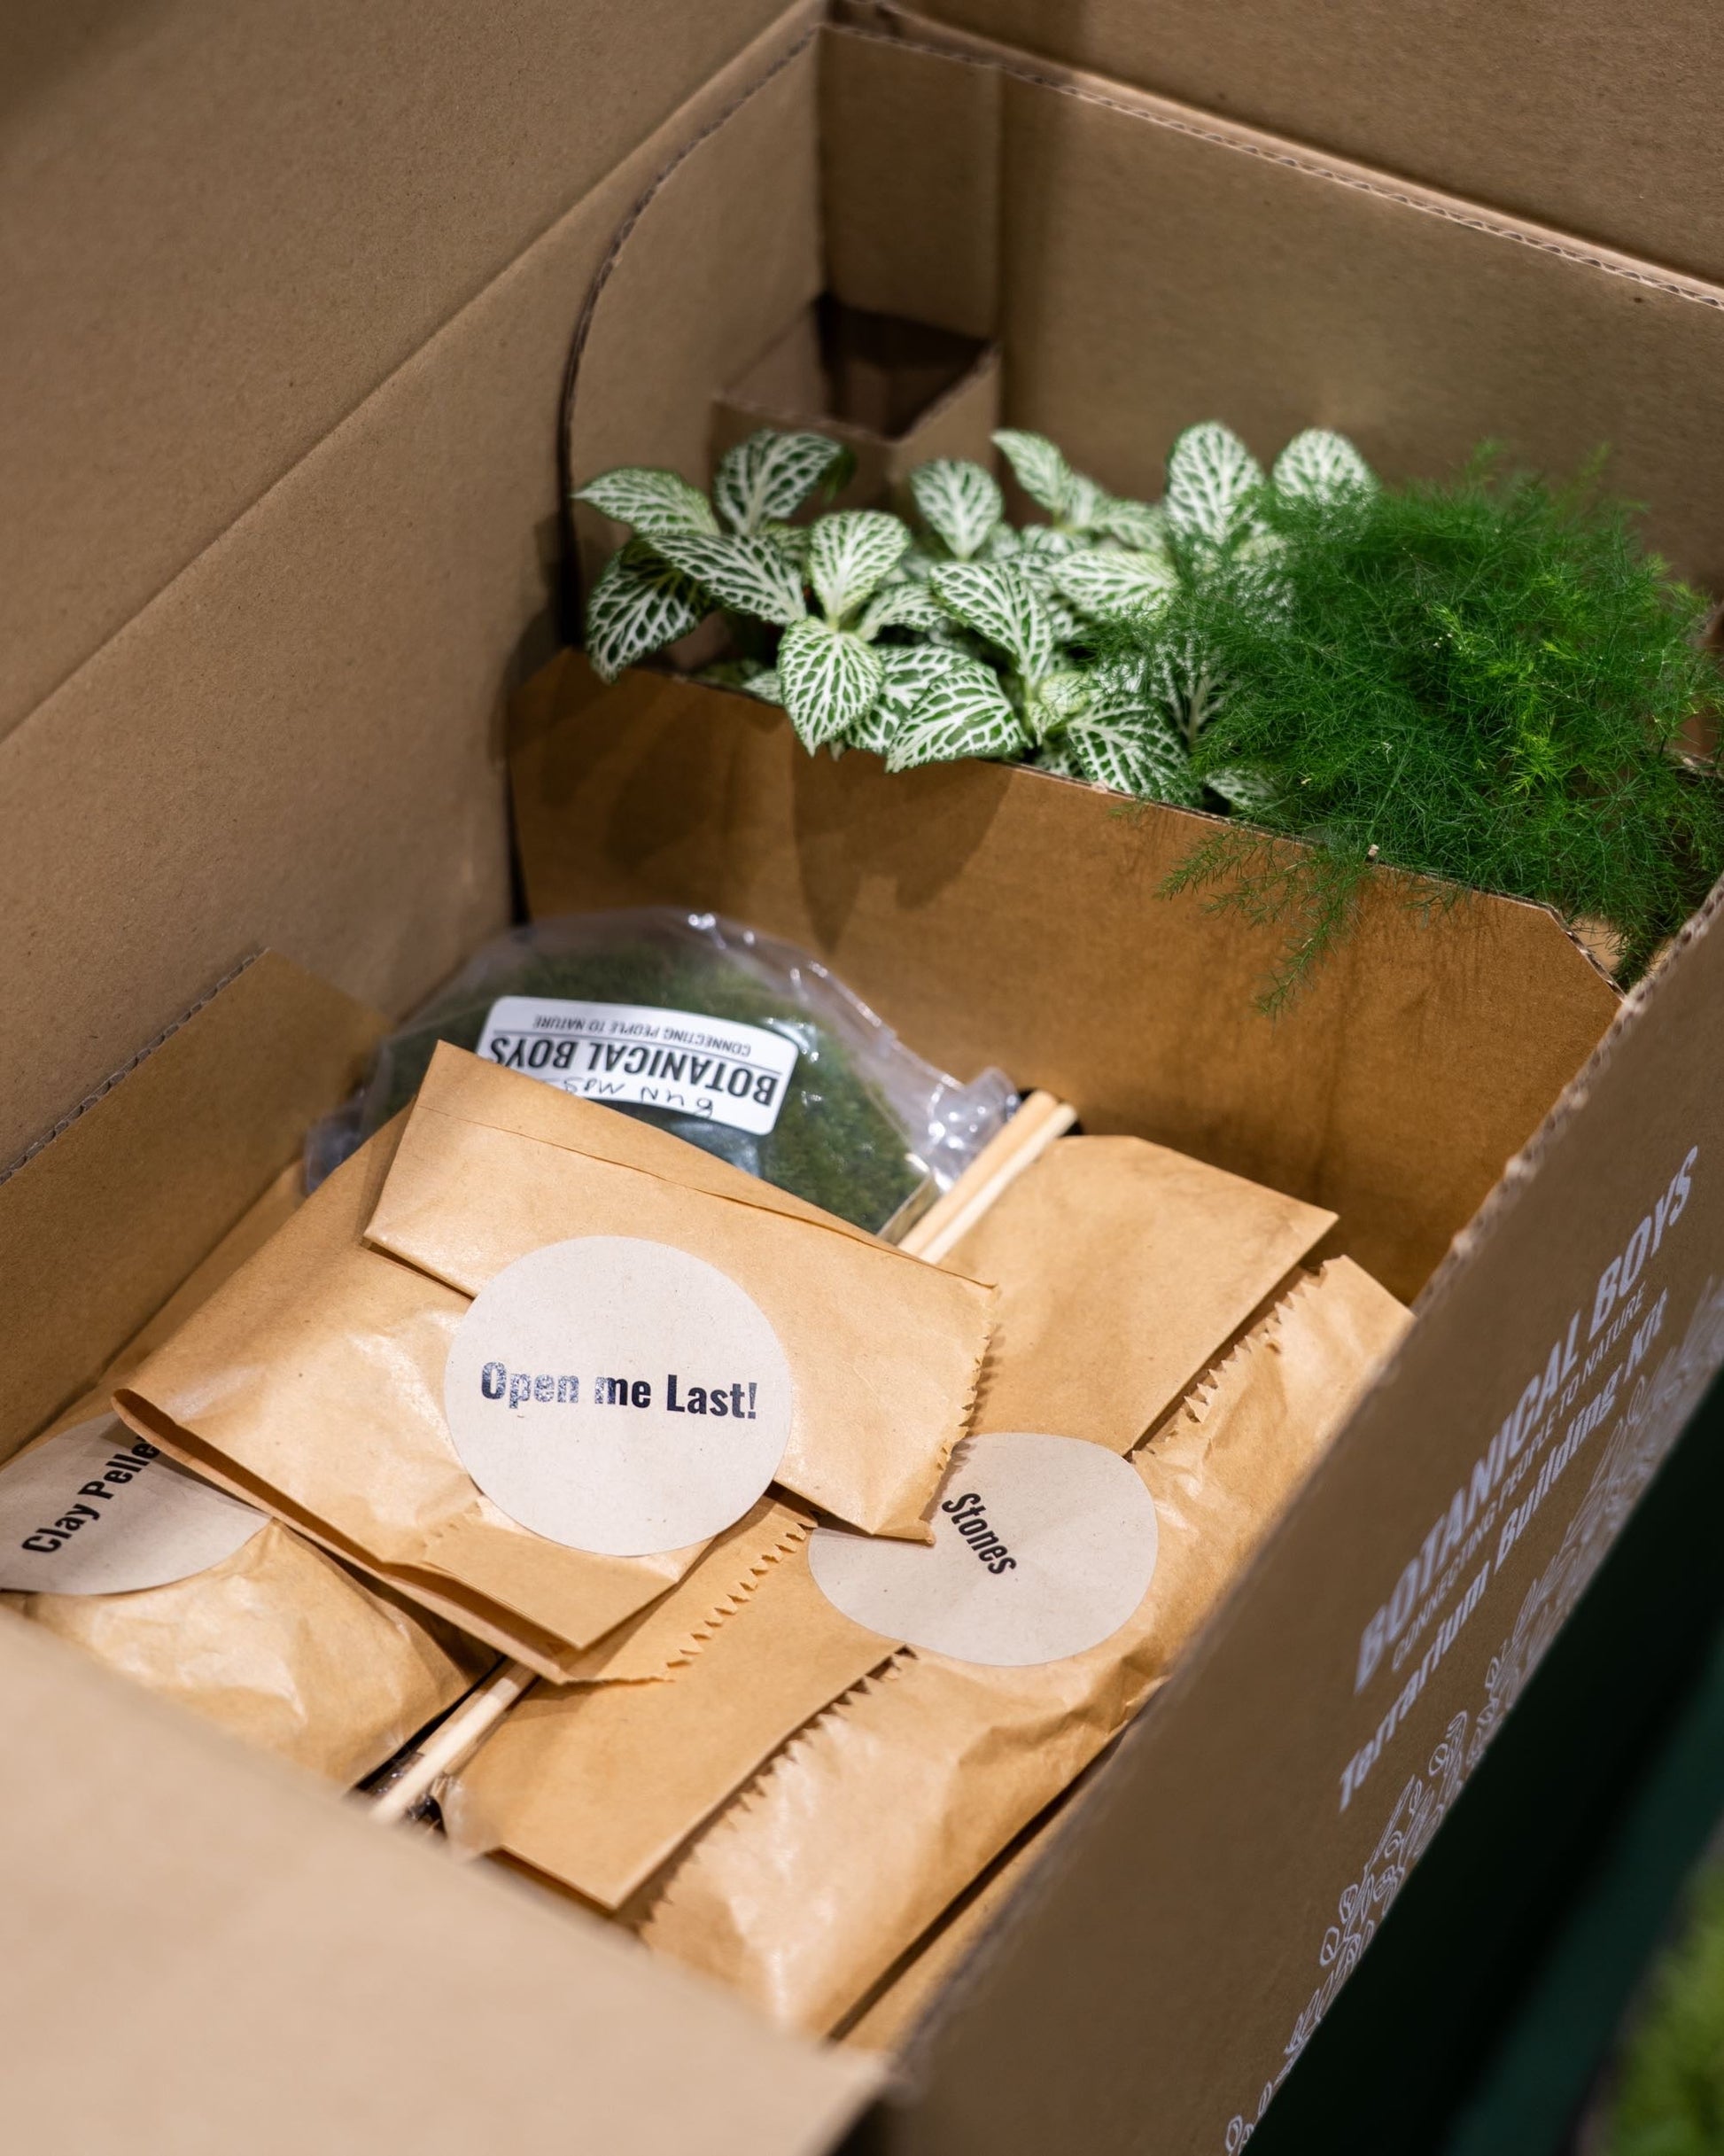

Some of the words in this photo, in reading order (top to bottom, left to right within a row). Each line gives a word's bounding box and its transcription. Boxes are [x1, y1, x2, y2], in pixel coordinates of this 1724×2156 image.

[490, 1036, 579, 1069] BOYS
[534, 1013, 584, 1030] NATURE
[588, 1018, 606, 1034] TO
[610, 1019, 659, 1038] PEOPLE
[664, 1024, 751, 1058] CONNECTING
[587, 1040, 779, 1107] BOTANICAL
[481, 1361, 579, 1409] Open
[594, 1376, 651, 1408] me
[666, 1374, 757, 1419] Last!
[1355, 1309, 1580, 1694] BOTANICAL
[1588, 1145, 1697, 1341] BOYS
[21, 1504, 100, 1553] Clay
[78, 1435, 160, 1499] Pelle
[1392, 1500, 1497, 1673] CONNECTING
[1498, 1406, 1557, 1512] PEOPLE
[1558, 1373, 1580, 1417] TO
[1581, 1280, 1646, 1385] NATURE
[942, 1492, 1016, 1575] Stones
[1340, 1560, 1489, 1813] Terrarium
[1494, 1363, 1623, 1574] Building
[1623, 1287, 1667, 1384] Kit
